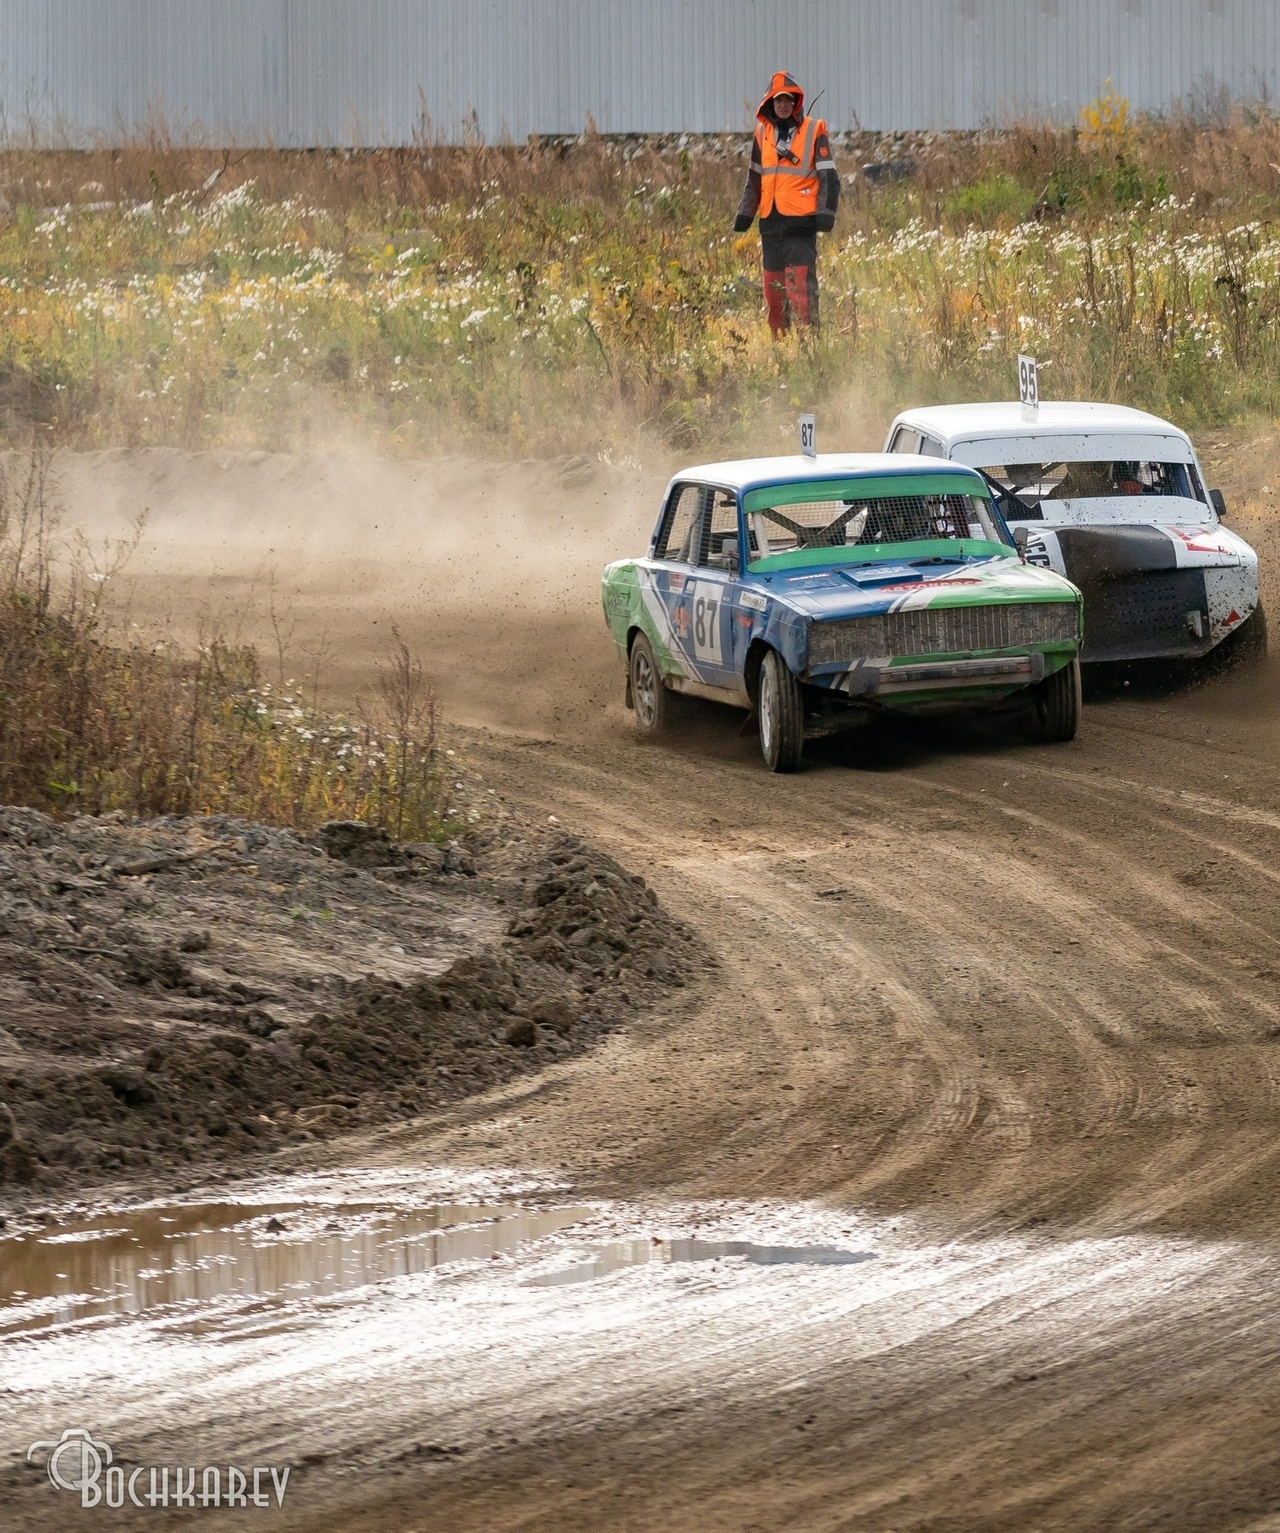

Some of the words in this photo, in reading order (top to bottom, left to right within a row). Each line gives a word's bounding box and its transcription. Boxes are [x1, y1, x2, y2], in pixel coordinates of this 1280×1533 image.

[1021, 361, 1036, 403] 95
[801, 422, 813, 447] 87
[695, 597, 718, 649] 87
